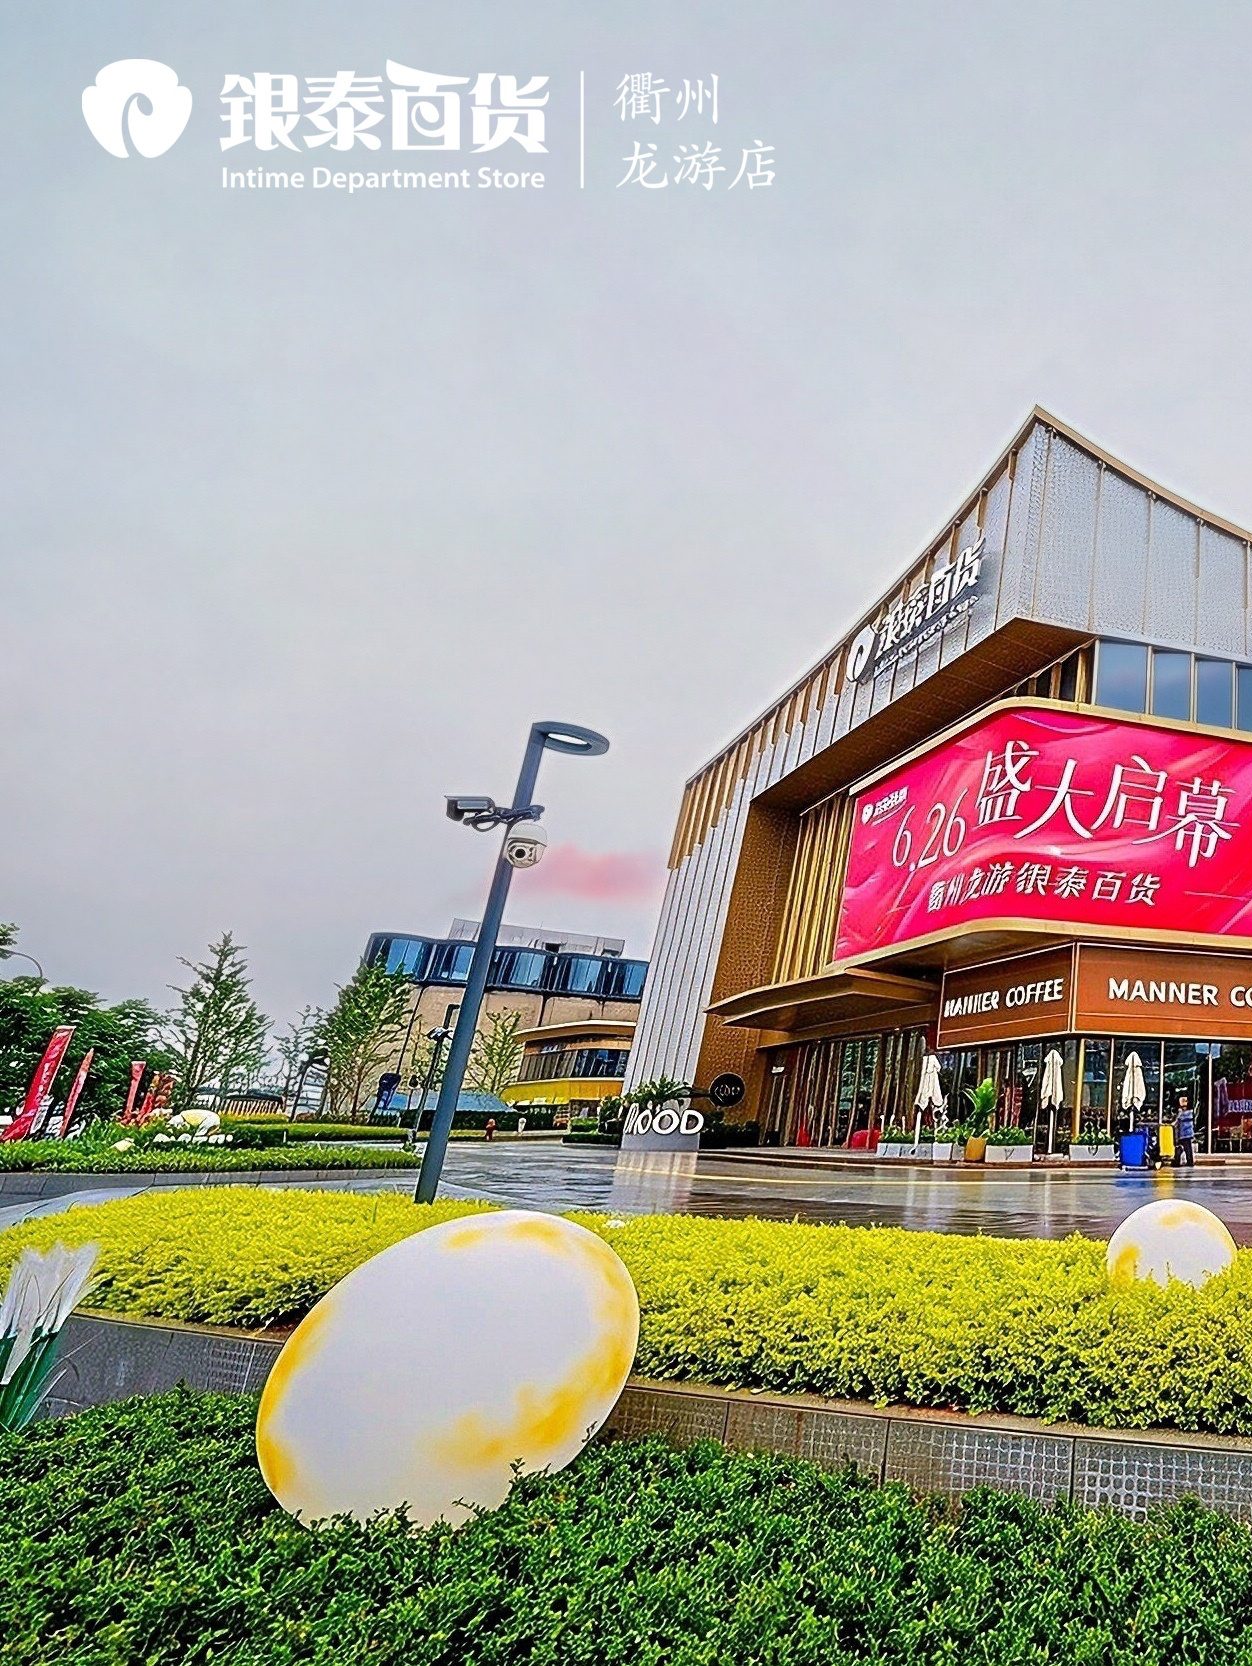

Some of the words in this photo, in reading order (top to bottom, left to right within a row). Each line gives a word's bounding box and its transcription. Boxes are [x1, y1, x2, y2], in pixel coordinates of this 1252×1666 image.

[892, 787, 969, 869] 6.26
[971, 740, 1241, 868] 盛大启幕
[1005, 978, 1064, 1008] COFFEE
[1108, 977, 1219, 1006] MANNER
